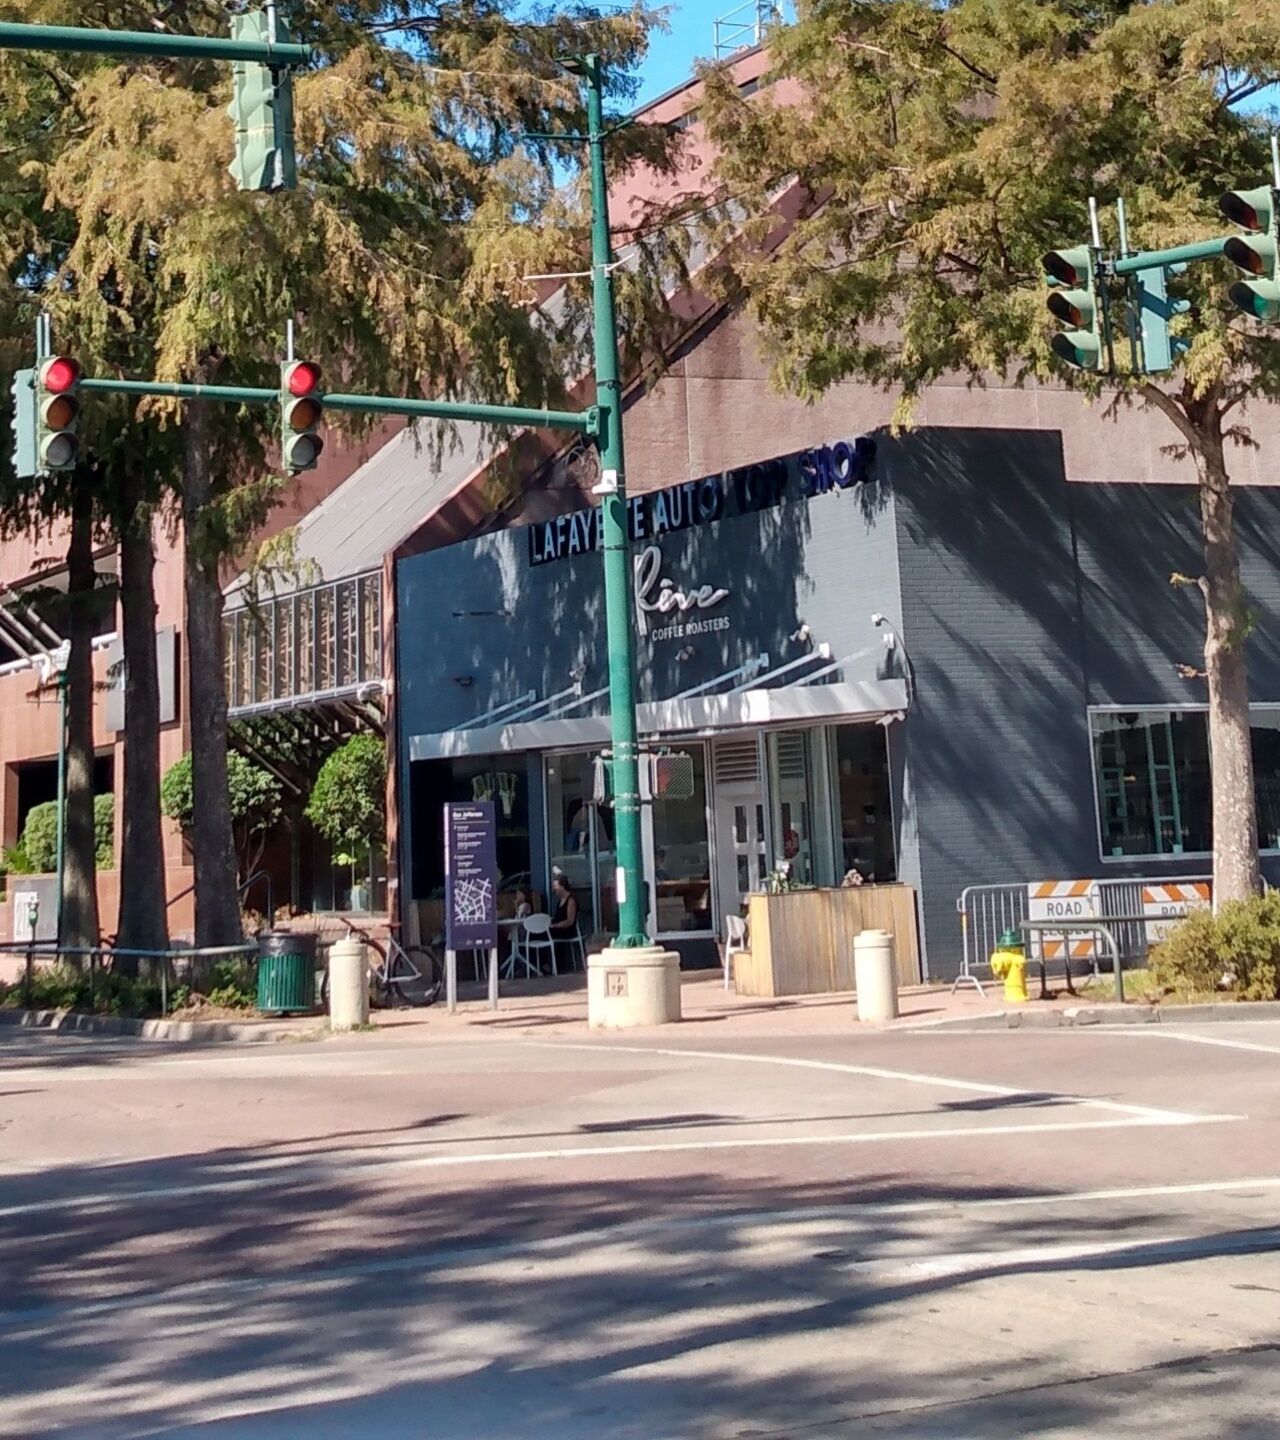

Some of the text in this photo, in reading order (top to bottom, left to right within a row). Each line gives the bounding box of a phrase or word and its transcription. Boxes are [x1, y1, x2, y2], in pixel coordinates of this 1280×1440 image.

[530, 496, 645, 561] LAFAYEE
[652, 476, 718, 535] AUTO
[797, 436, 878, 496] SHOP
[651, 616, 730, 641] COFFEE ROASTERS
[1047, 901, 1082, 916] ROAD
